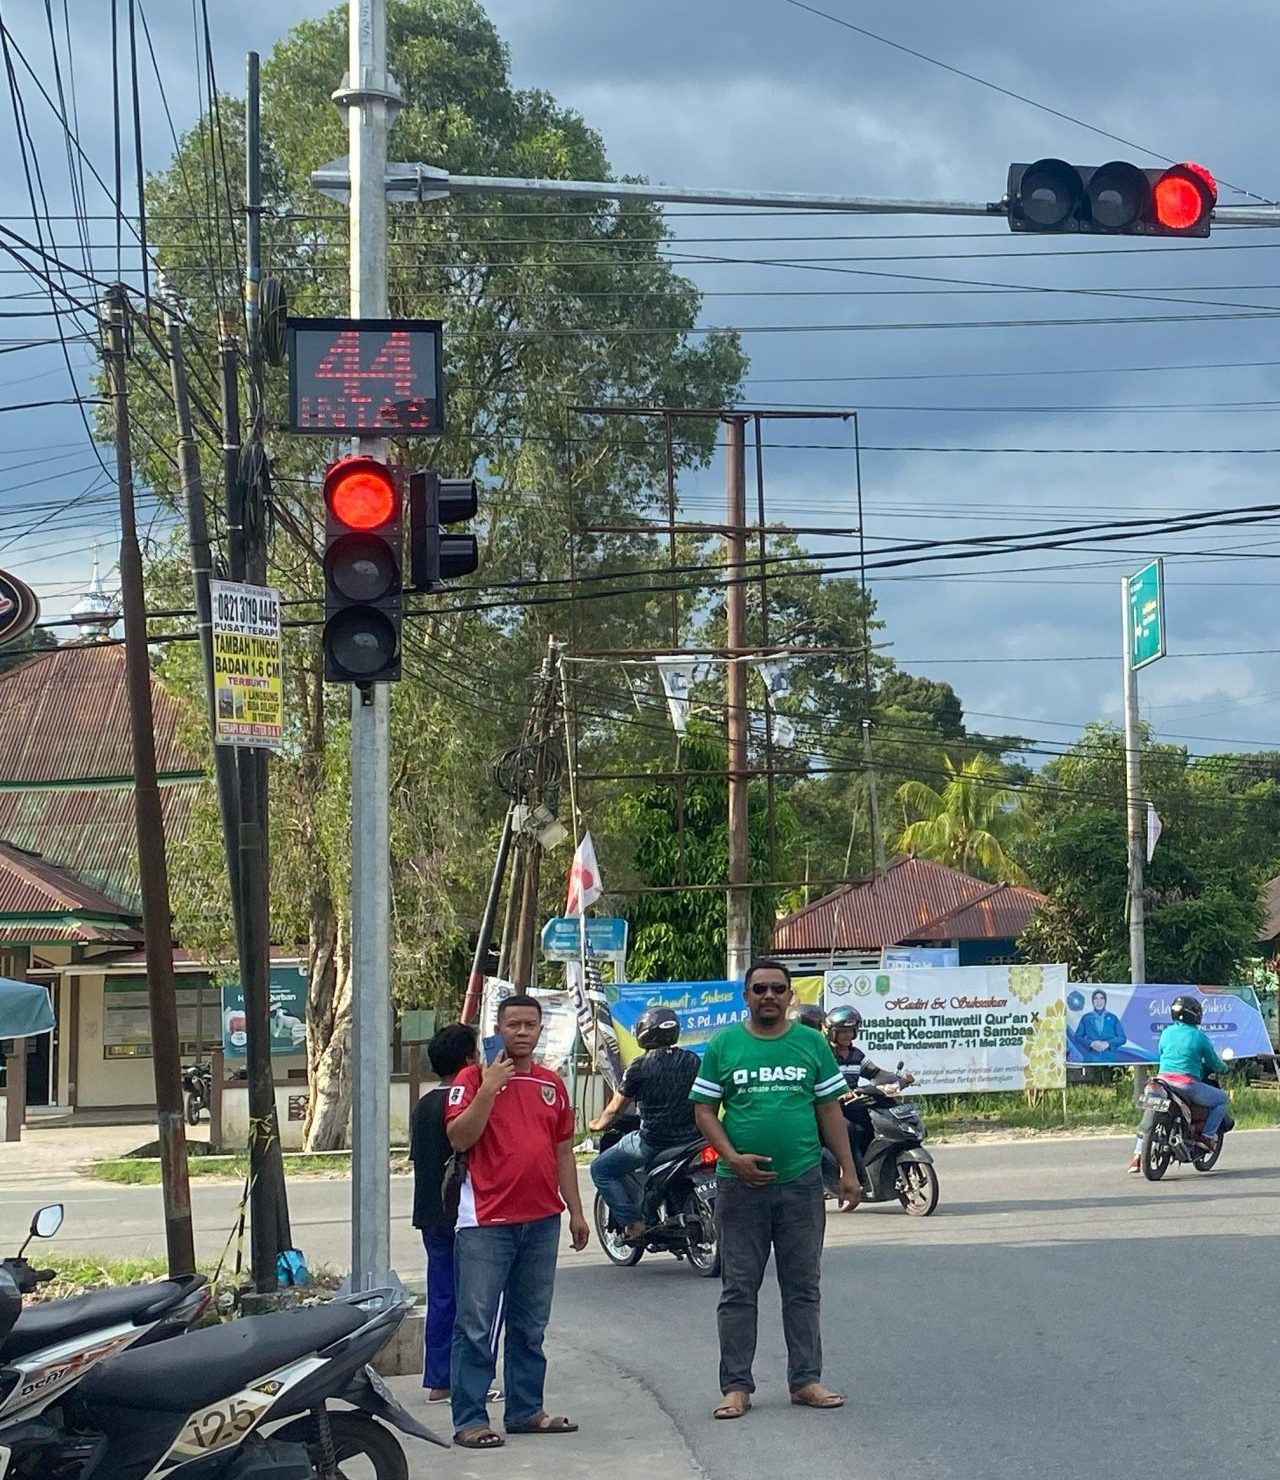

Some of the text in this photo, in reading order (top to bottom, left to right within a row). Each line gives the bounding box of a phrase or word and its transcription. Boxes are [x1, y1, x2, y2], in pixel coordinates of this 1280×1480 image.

[315, 331, 417, 396] 44
[218, 593, 239, 623] 0821
[259, 599, 278, 628] 4445
[214, 622, 278, 638] PUSAT TERAPI
[214, 634, 279, 659] TAMBAH TINGGI
[215, 657, 280, 679] BADAN 1-6 CM
[228, 676, 270, 688] TERBUKTI
[248, 690, 279, 702] LANGSUNG
[885, 995, 1008, 1010] Hadiri & Sukseskan
[929, 1014, 982, 1027] Tilawatil
[985, 1012, 1028, 1026] Qur'an
[1031, 1011, 1039, 1023] X
[909, 1027, 981, 1040] Kecamatan
[983, 1024, 1034, 1038] Sambas
[868, 1041, 895, 1051] Desa
[897, 1039, 949, 1050] Pendawan
[951, 1040, 956, 1049] 7
[966, 1039, 977, 1048] 11
[979, 1038, 997, 1047] Mei
[999, 1036, 1024, 1046] 2025
[759, 1066, 807, 1082] BASF
[187, 1400, 257, 1448] 125
